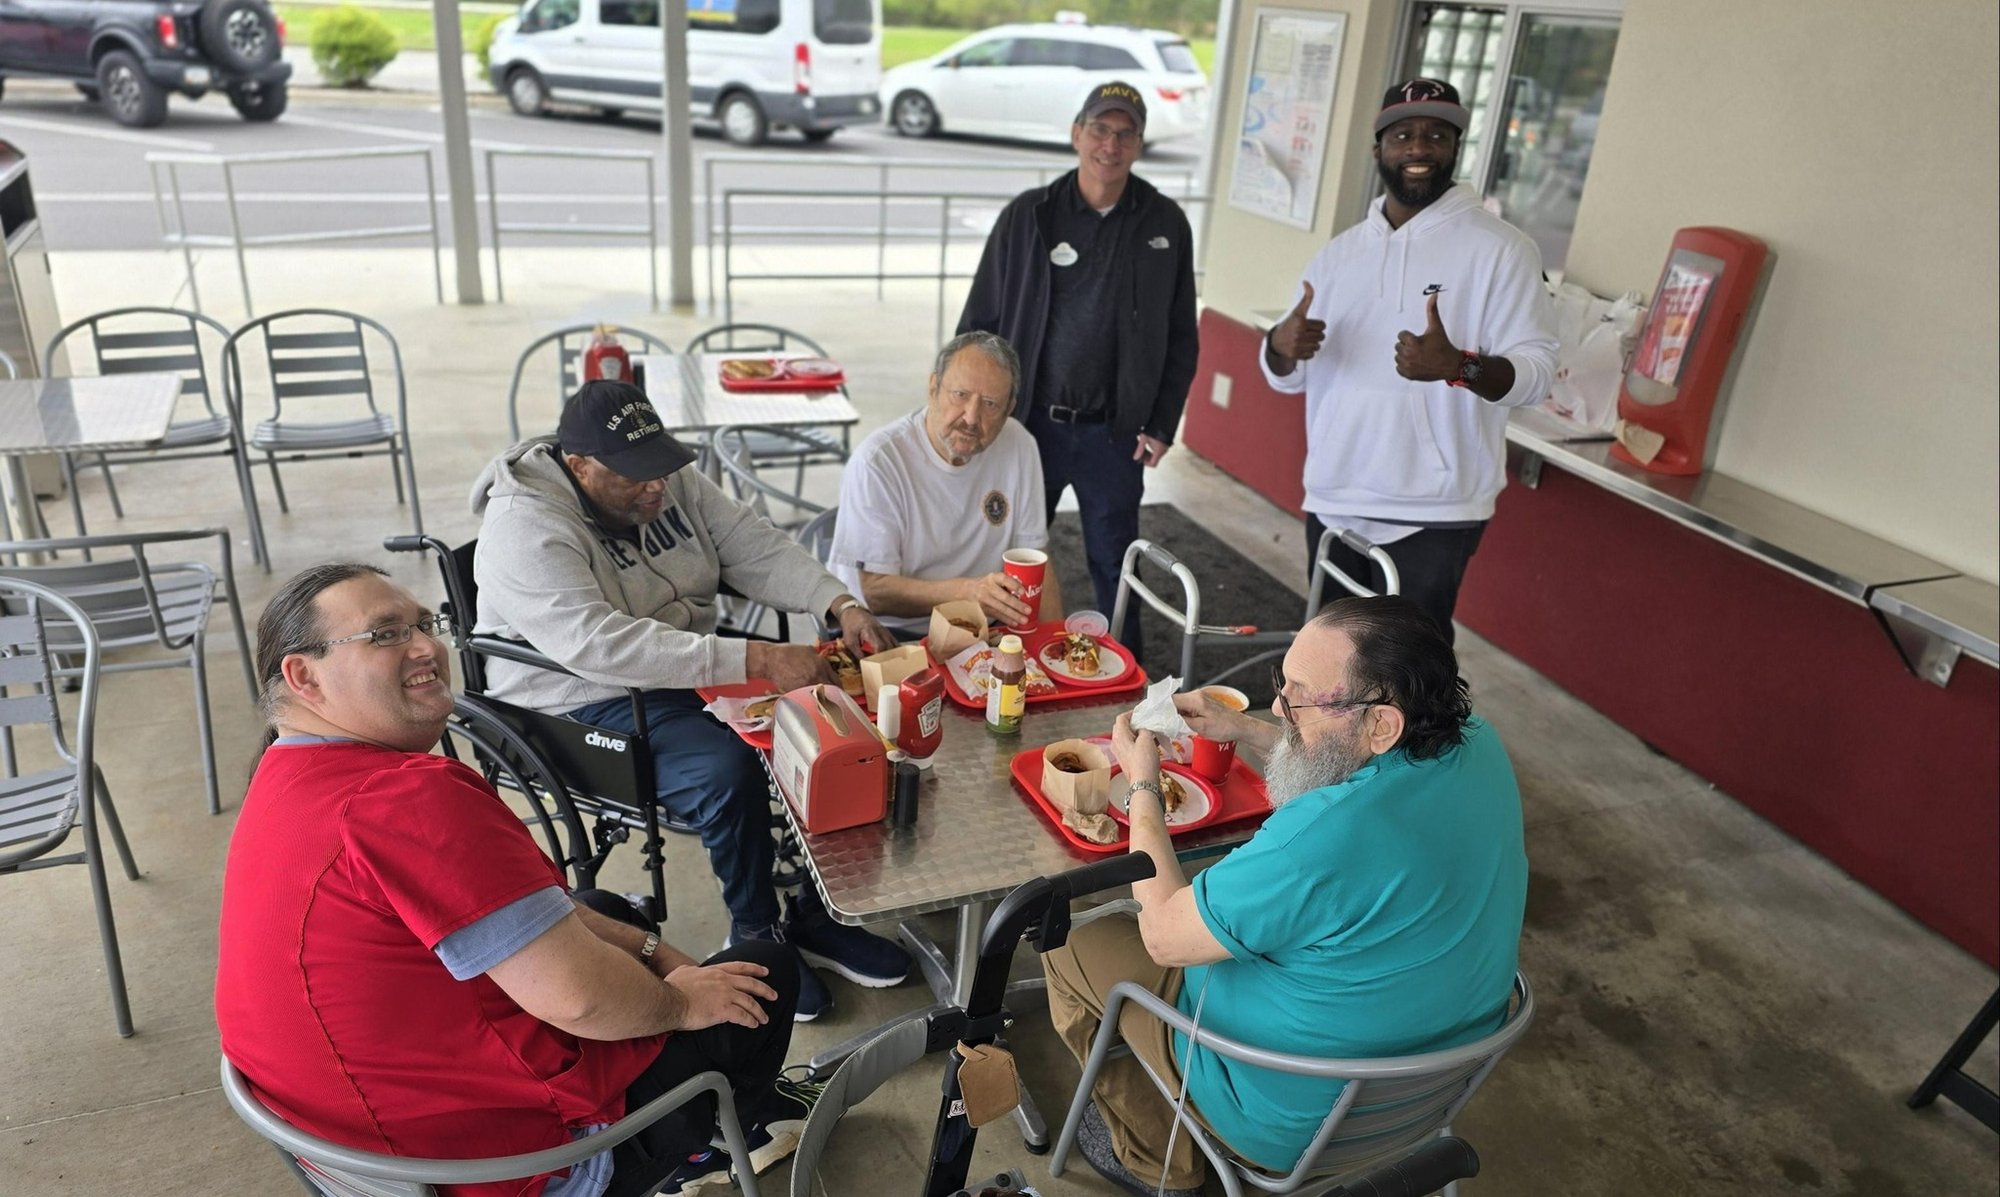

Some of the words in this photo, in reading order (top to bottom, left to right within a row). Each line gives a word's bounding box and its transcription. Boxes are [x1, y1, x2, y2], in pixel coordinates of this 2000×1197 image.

[1101, 86, 1140, 104] NAVY
[606, 414, 623, 431] U.S.
[621, 403, 635, 417] AIR
[626, 423, 660, 442] RETIRED
[585, 731, 627, 752] drive
